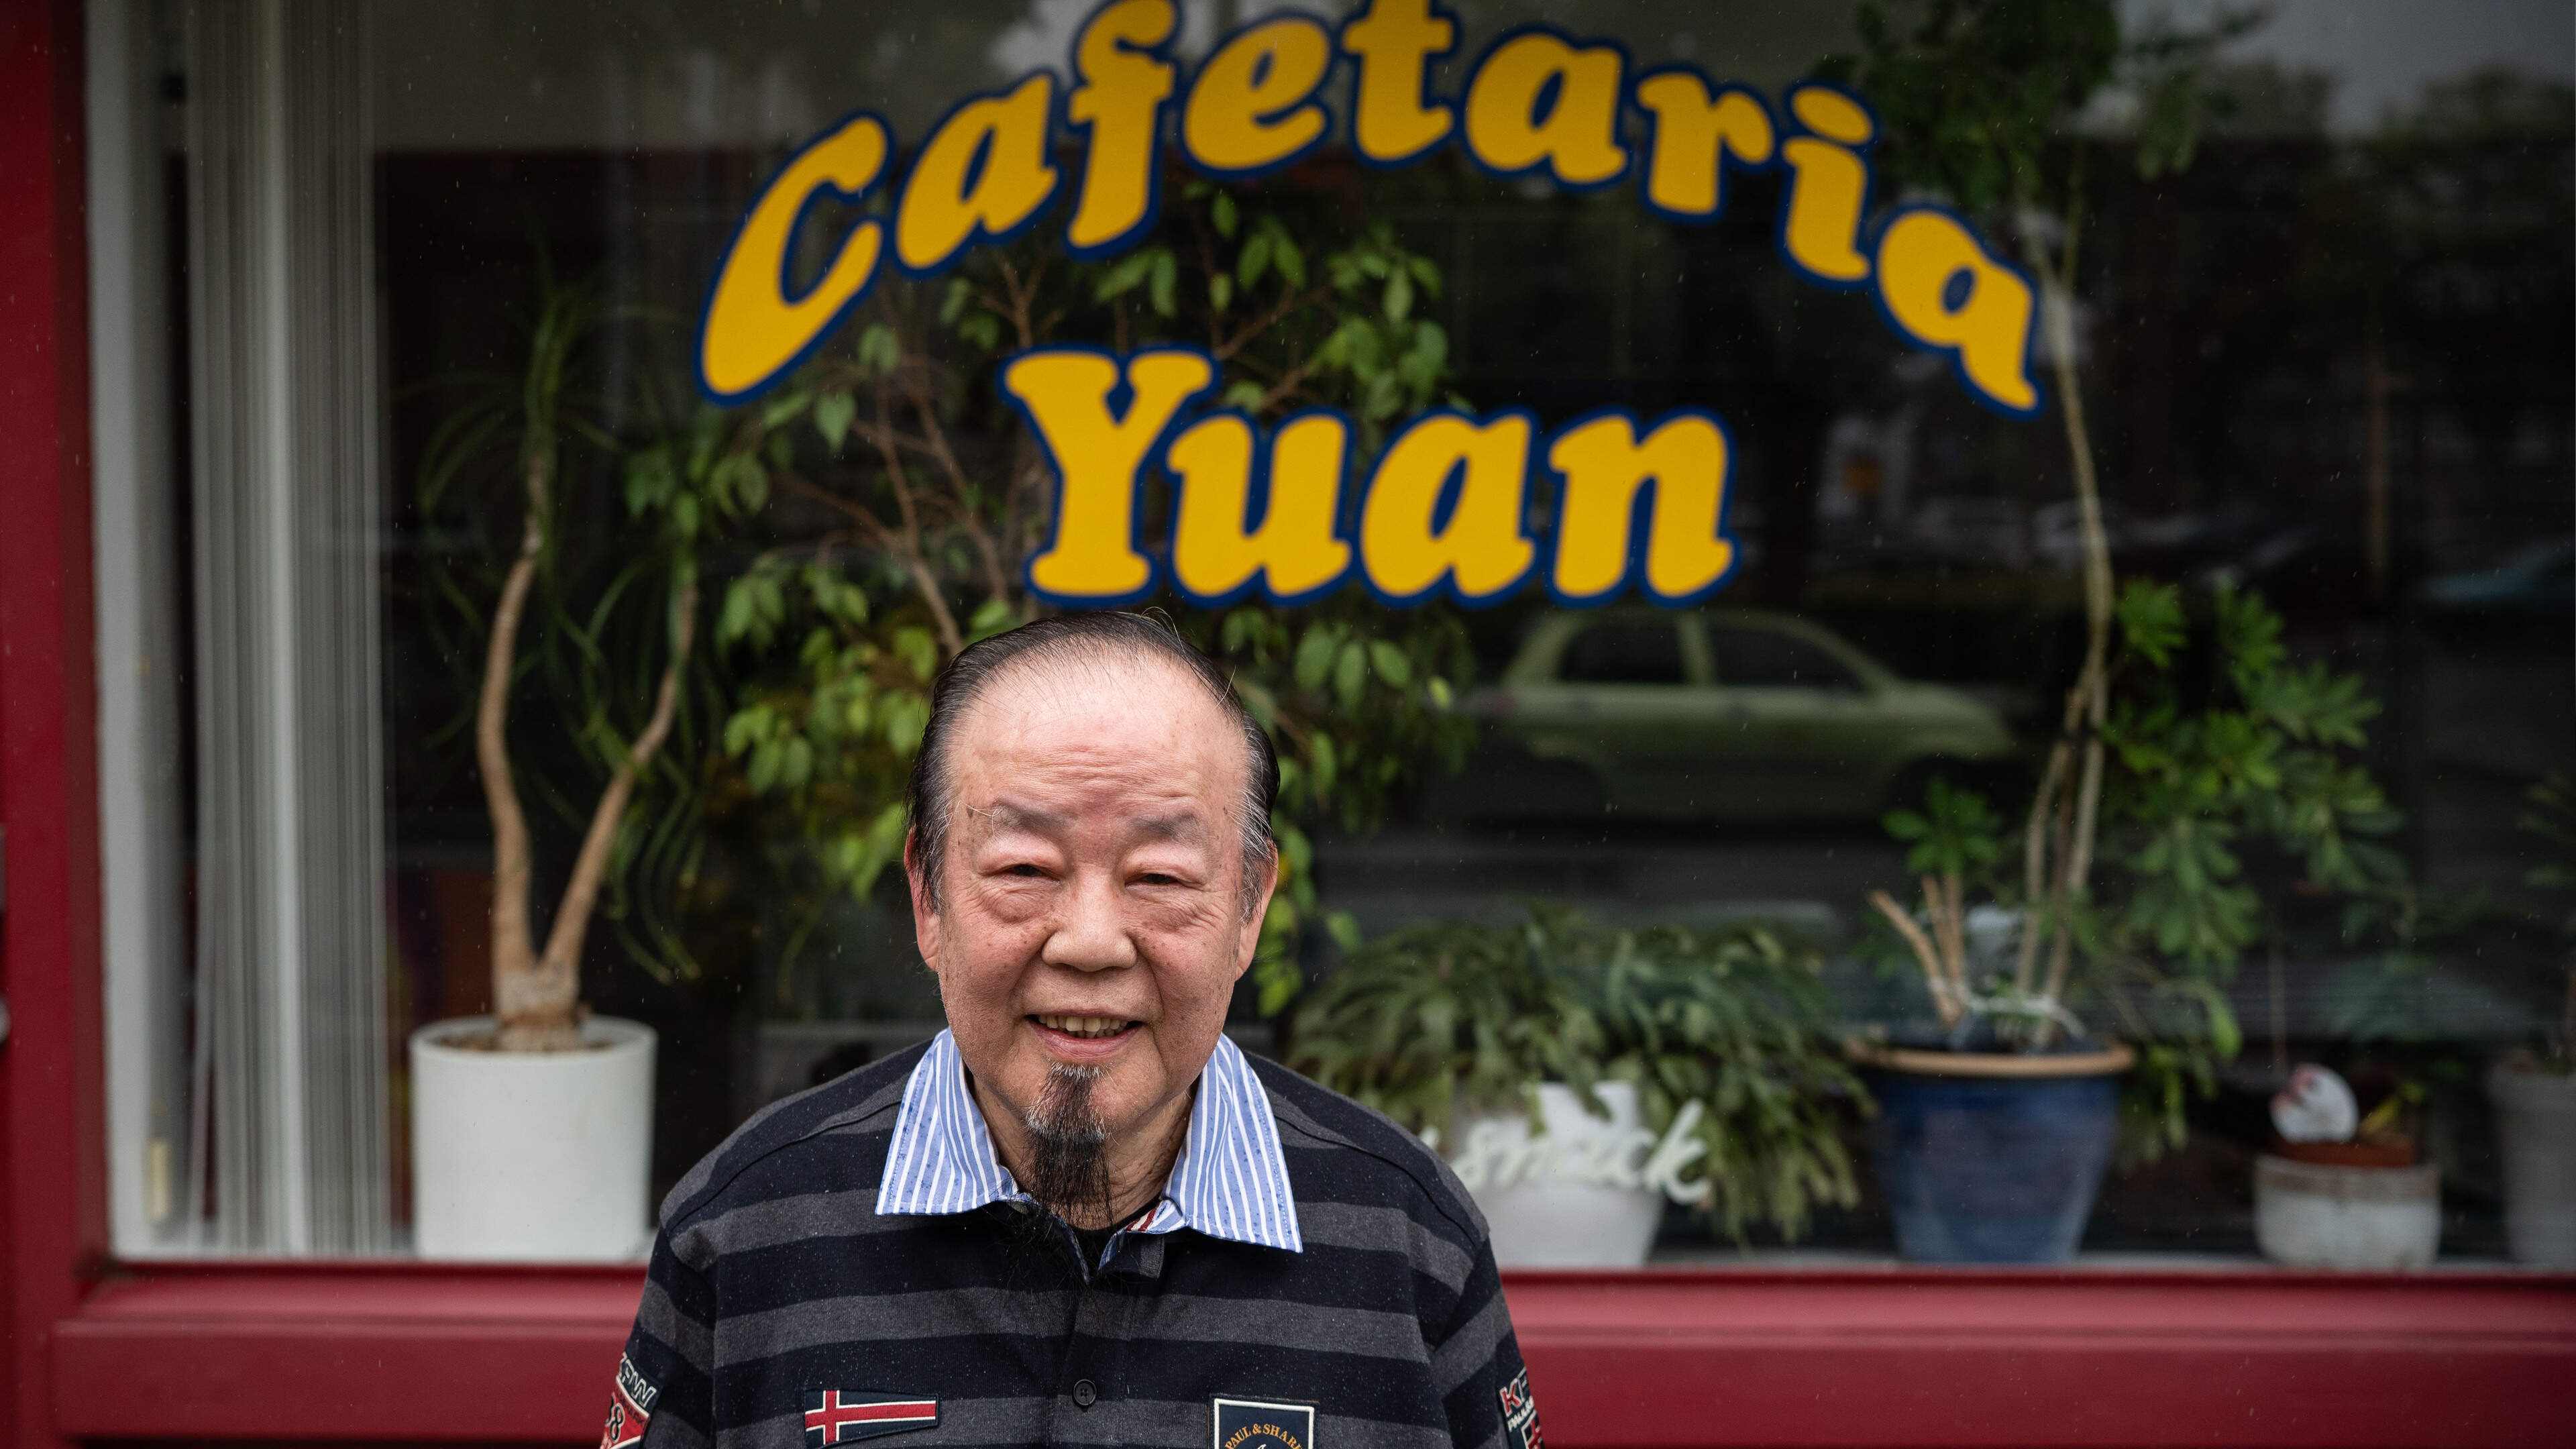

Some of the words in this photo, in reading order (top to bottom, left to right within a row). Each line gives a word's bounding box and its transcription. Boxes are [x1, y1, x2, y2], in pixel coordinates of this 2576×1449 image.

[698, 0, 2043, 417] Cafetaria
[1001, 346, 1739, 606] Yuan
[604, 1391, 626, 1444] 8
[1224, 1426, 1252, 1449] PAUL
[1252, 1423, 1262, 1435] &
